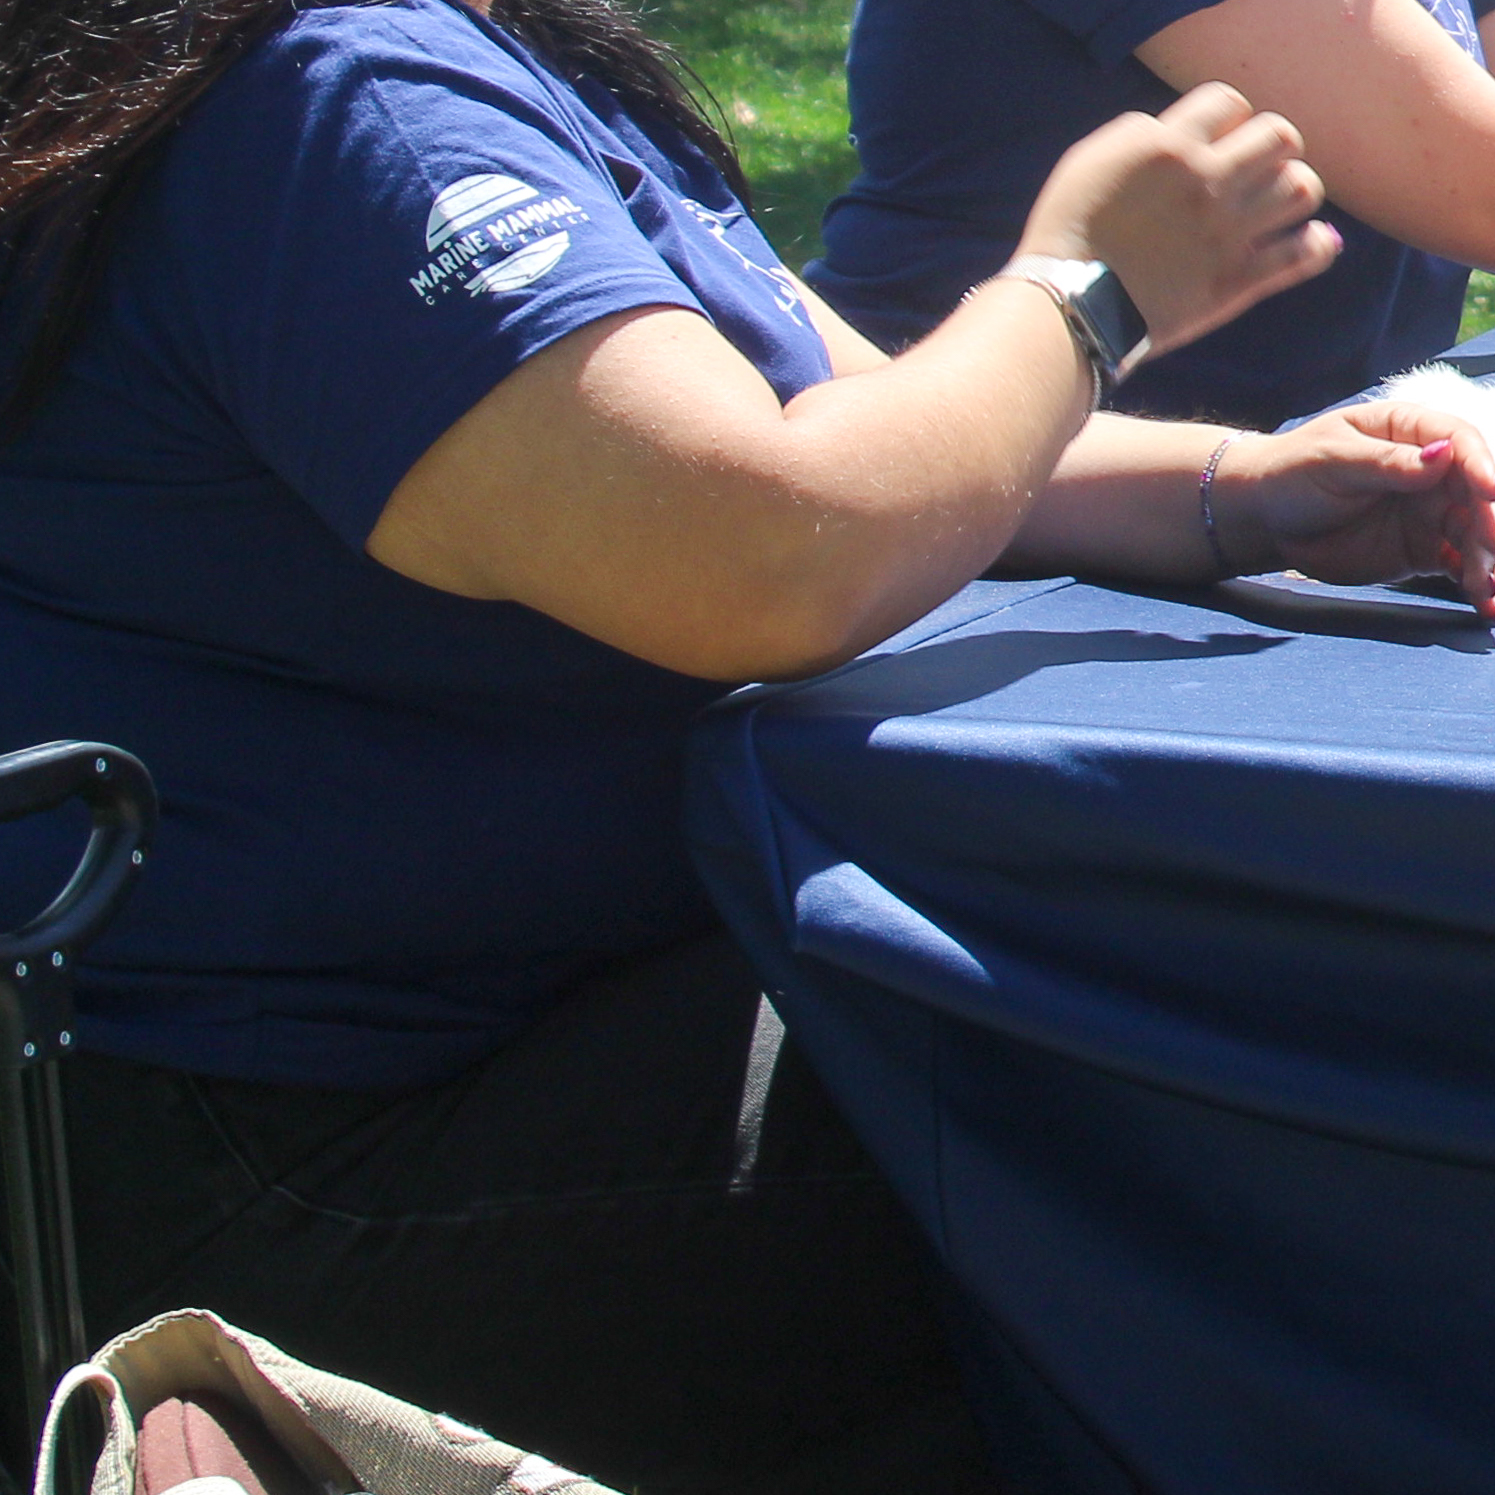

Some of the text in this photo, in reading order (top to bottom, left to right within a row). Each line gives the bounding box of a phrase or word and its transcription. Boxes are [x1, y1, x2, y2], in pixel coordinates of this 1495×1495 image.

[486, 195, 582, 242] MAMMAL
[425, 212, 591, 306] CARE CENTER
